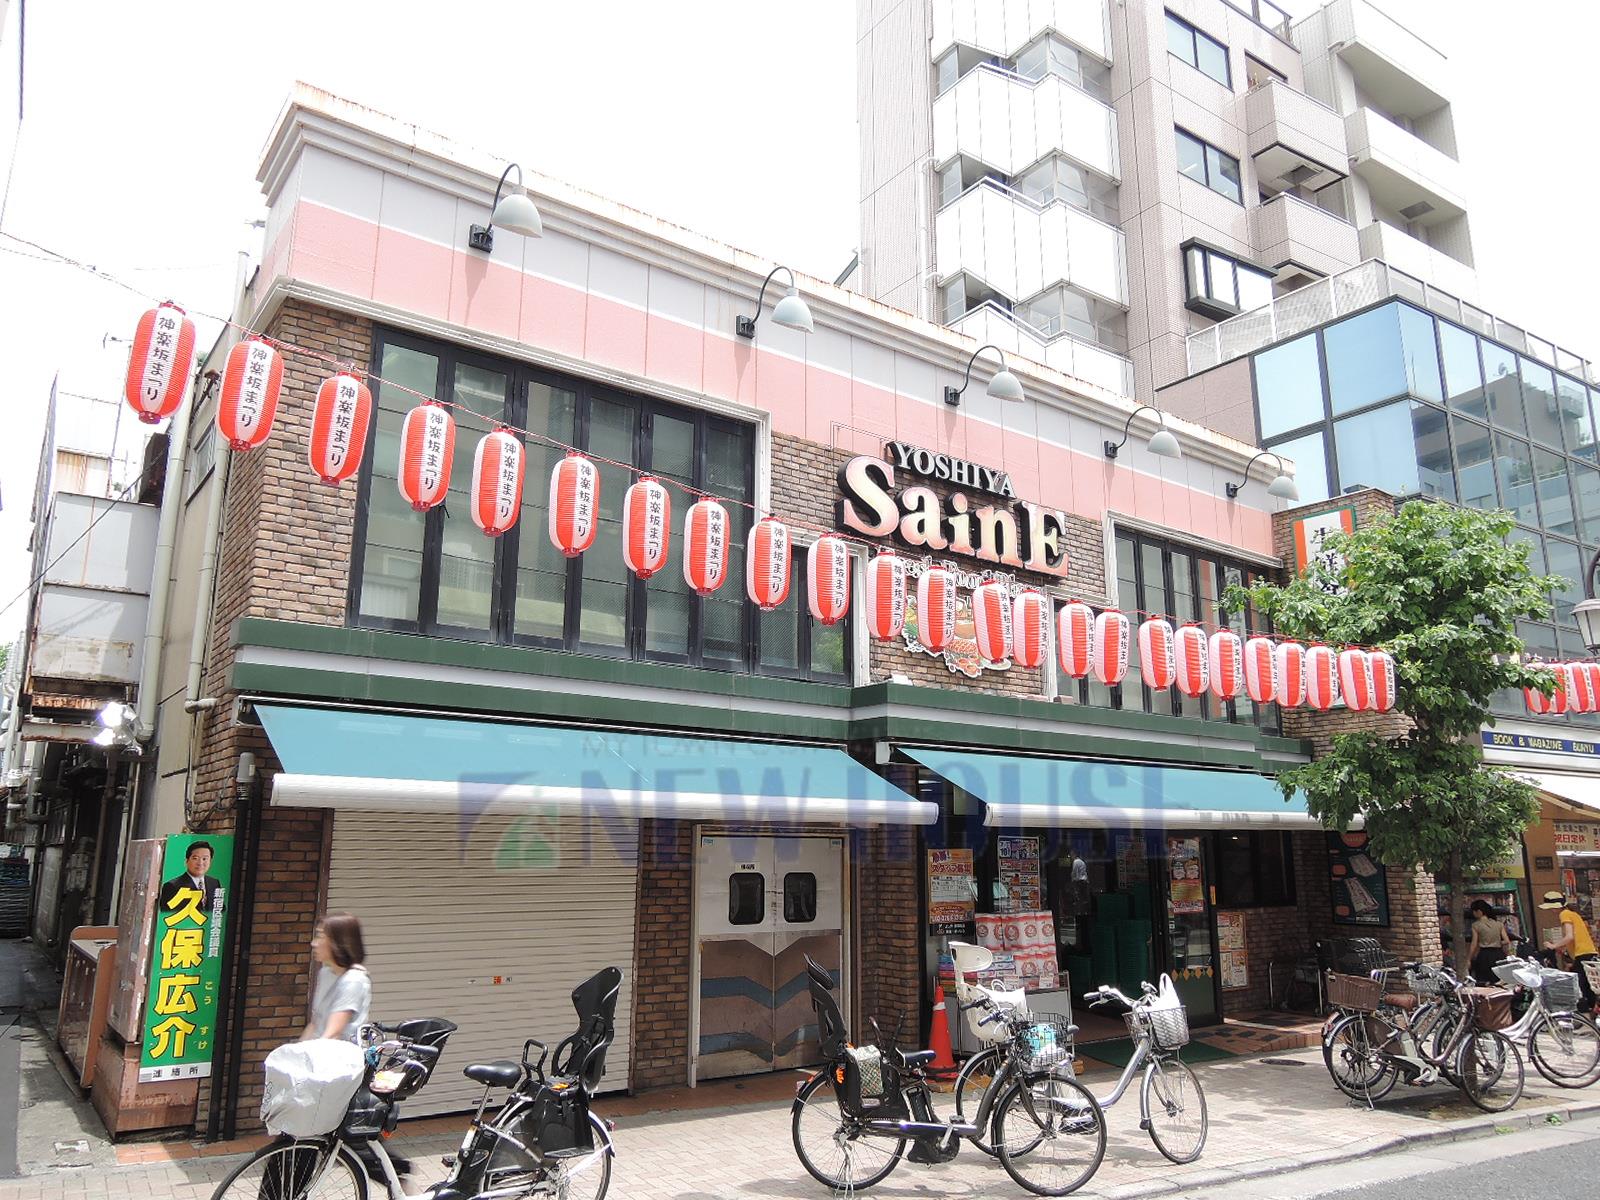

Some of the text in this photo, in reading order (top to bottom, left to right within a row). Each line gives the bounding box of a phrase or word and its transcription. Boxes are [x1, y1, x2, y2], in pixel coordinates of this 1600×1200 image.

[146, 316, 176, 401] 神楽坂まつり
[241, 347, 269, 428] 神楽坂まつり
[330, 385, 357, 467] 神楽坂まつり
[424, 411, 444, 491] 神楽坂まつり
[501, 442, 518, 518] 神楽坂まつり
[577, 464, 594, 537] 神楽坂まつり
[890, 441, 1018, 498] YOSHIYA
[649, 489, 663, 560] 神楽坂まつり
[708, 510, 723, 580] 神楽坂まつり
[841, 455, 1070, 578] SainE
[771, 527, 785, 595] 神楽坂まつり
[1493, 734, 1514, 746] BOOK
[1519, 737, 1525, 746] &
[1528, 738, 1563, 750] MAGAZINE
[150, 887, 208, 1059] 久保広介
